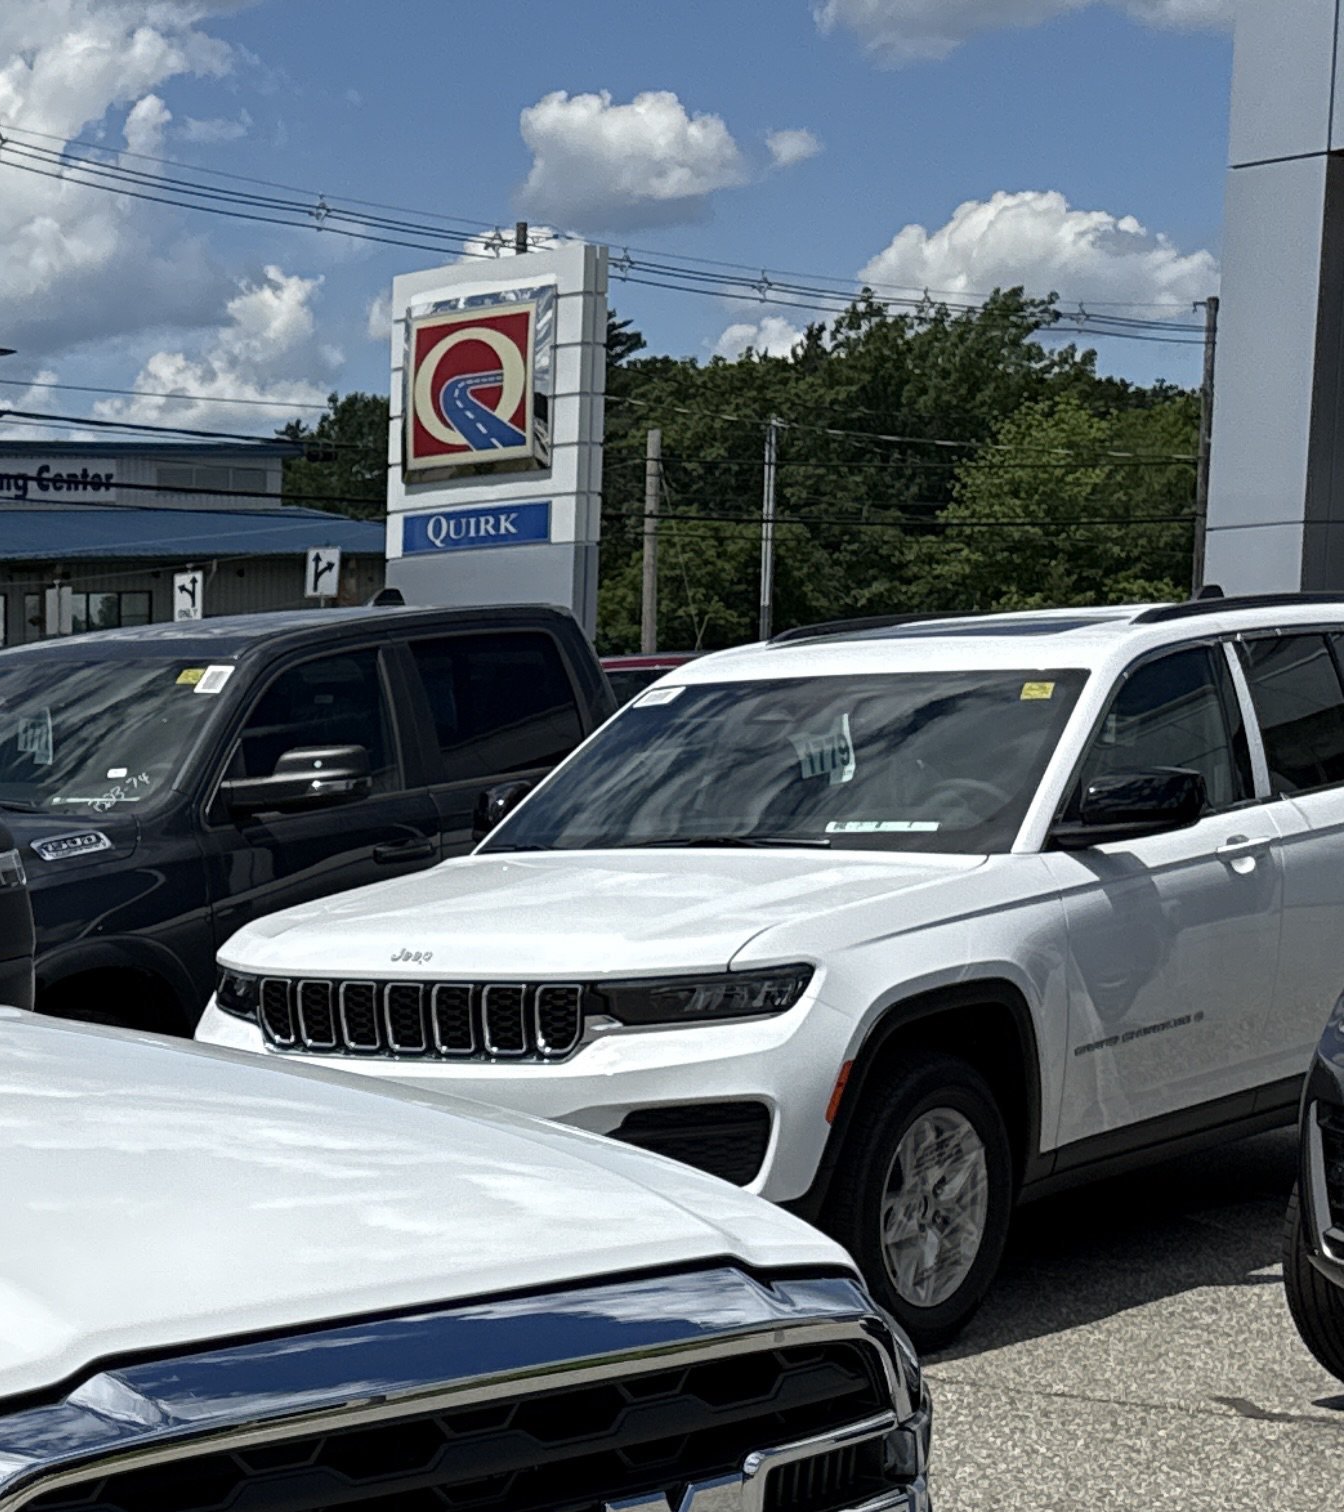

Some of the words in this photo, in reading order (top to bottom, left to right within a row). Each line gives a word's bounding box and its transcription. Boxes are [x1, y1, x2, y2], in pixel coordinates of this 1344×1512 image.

[37, 464, 114, 492] Center
[427, 512, 518, 547] QUIRK
[177, 608, 198, 619] ONLY
[391, 948, 434, 965] Jeep
